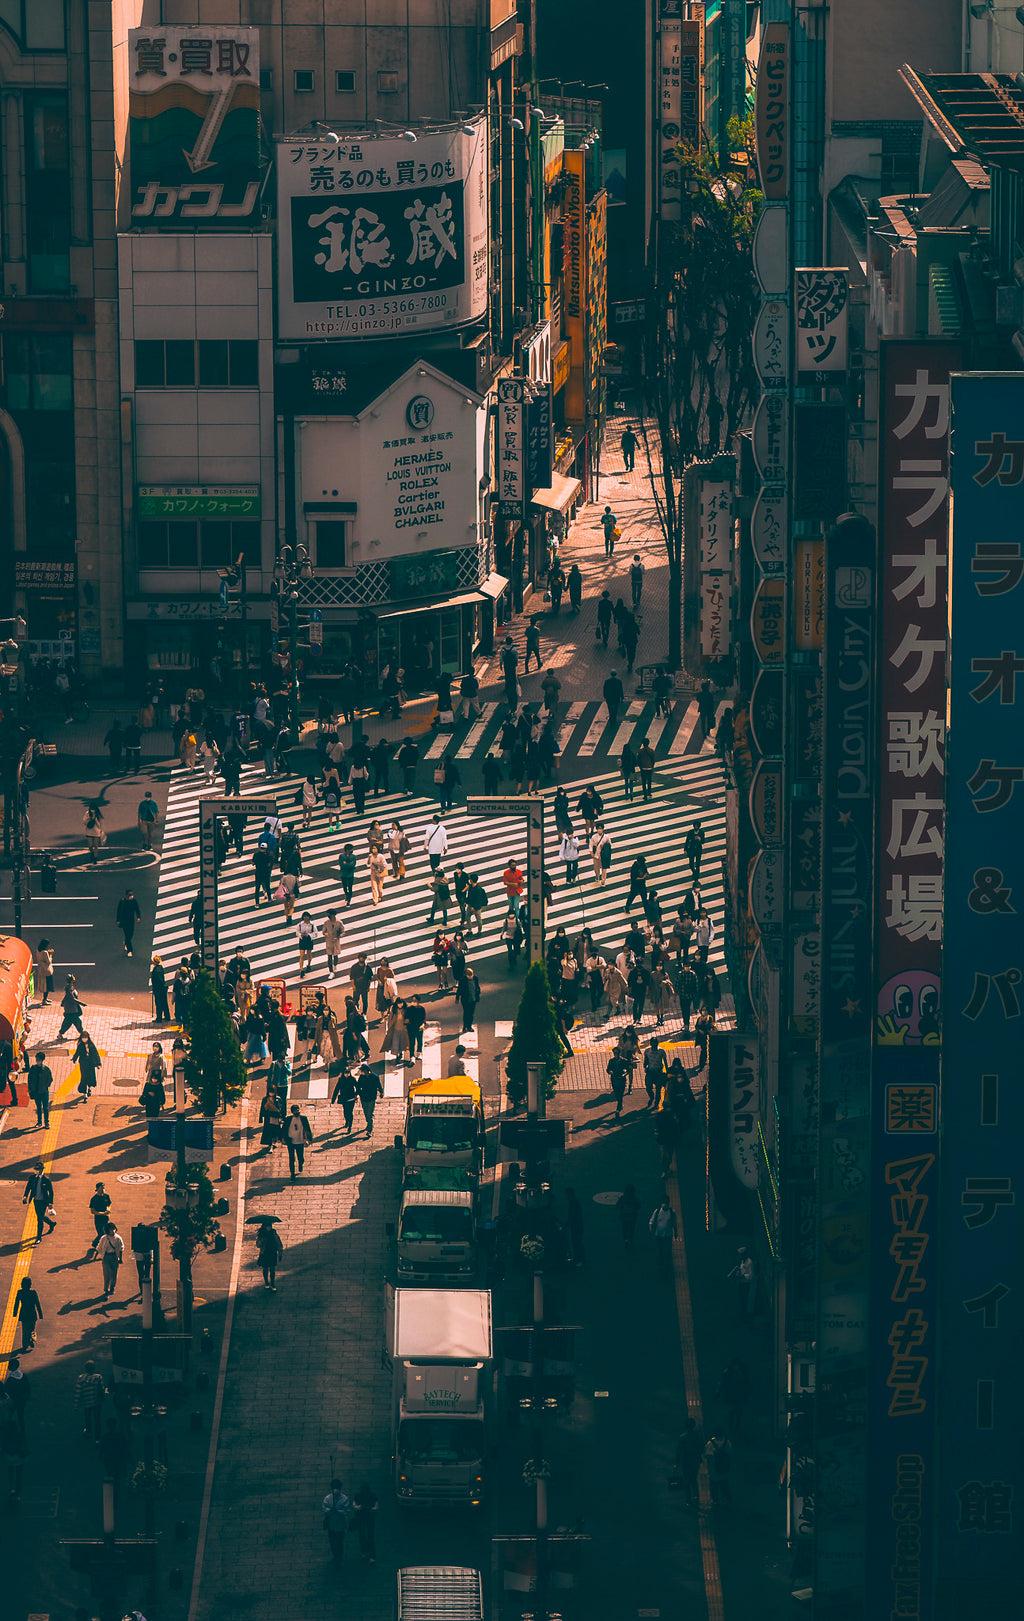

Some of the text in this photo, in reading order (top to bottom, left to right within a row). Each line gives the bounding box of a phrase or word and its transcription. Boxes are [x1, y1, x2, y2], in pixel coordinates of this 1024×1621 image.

[135, 38, 250, 76] 質・買取
[290, 146, 363, 163] ブランド品
[132, 182, 260, 217] カワノ
[567, 173, 581, 319] Matsumoto Kiyoshi
[326, 294, 447, 319] TEL.03-5366-7800
[804, 279, 838, 363] ダーツ
[306, 317, 402, 332] http://ginzo.jp
[387, 462, 451, 480] LOUIS VUITTON
[400, 477, 439, 491] ROLEX
[162, 500, 253, 512] カワノ・クォーク
[394, 500, 445, 517] BVLGARI
[398, 490, 440, 504] Cartier
[395, 513, 443, 529] CHANEL
[706, 495, 719, 563] イタリアン
[709, 656, 723, 664] 7F
[886, 369, 949, 942] カラオケ歌広場
[203, 832, 215, 929] GODZILLA
[733, 1044, 754, 1133] トラノコ
[888, 1087, 936, 1131] 薬
[885, 1153, 935, 1417] マツモトキヨシ
